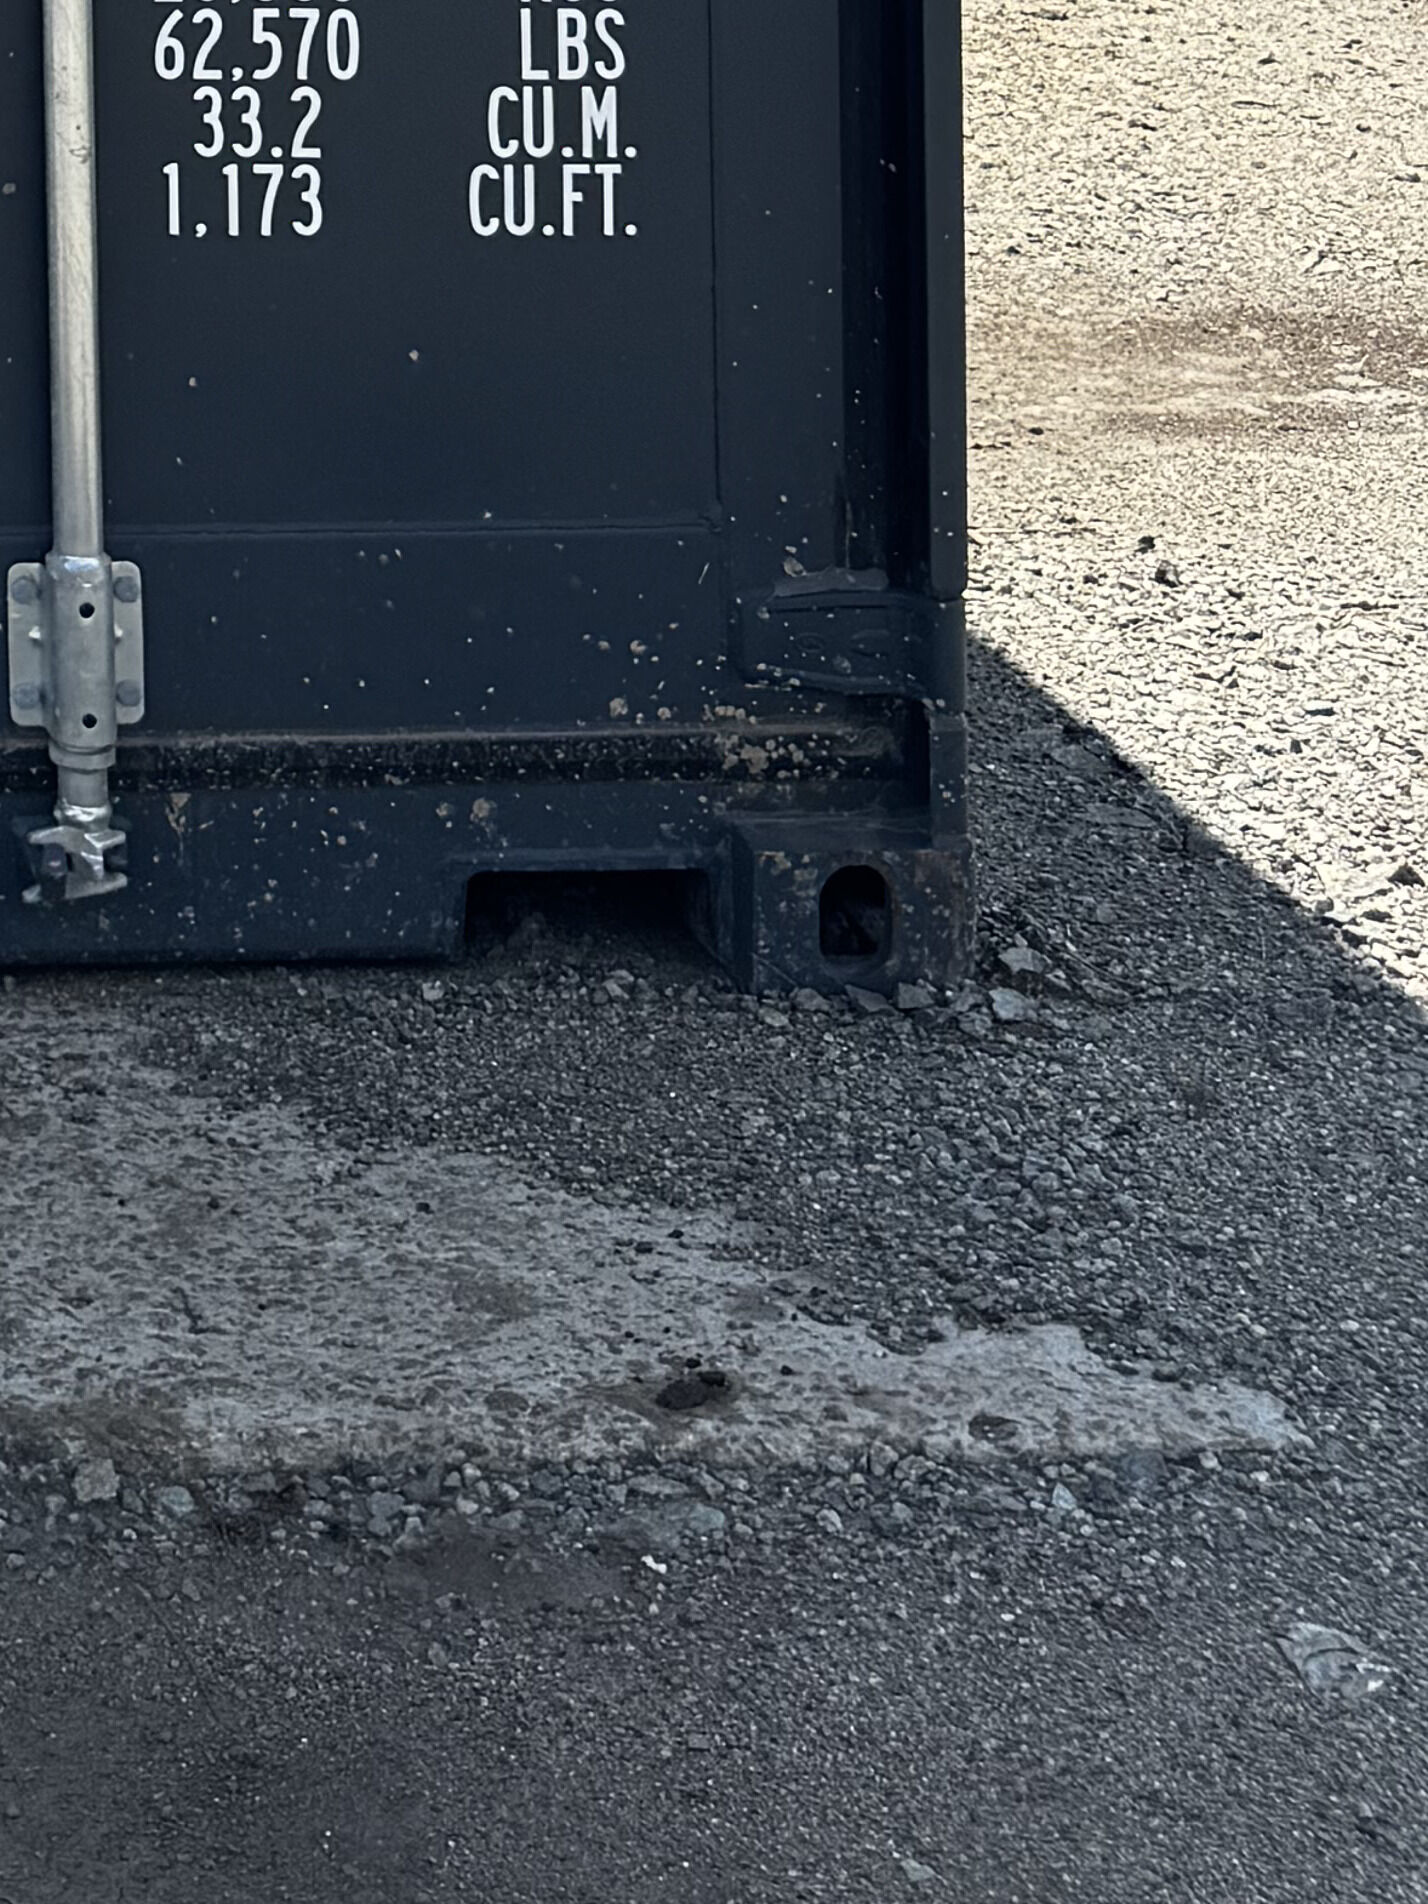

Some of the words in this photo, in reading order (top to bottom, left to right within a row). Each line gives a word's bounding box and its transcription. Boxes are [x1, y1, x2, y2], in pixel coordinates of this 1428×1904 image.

[155, 8, 359, 81] 62,570
[521, 8, 625, 80] LBS
[194, 86, 321, 158] 33.2
[488, 86, 636, 158] CU.M.
[163, 163, 322, 237] 1,173
[470, 164, 636, 236] CU.FT.
